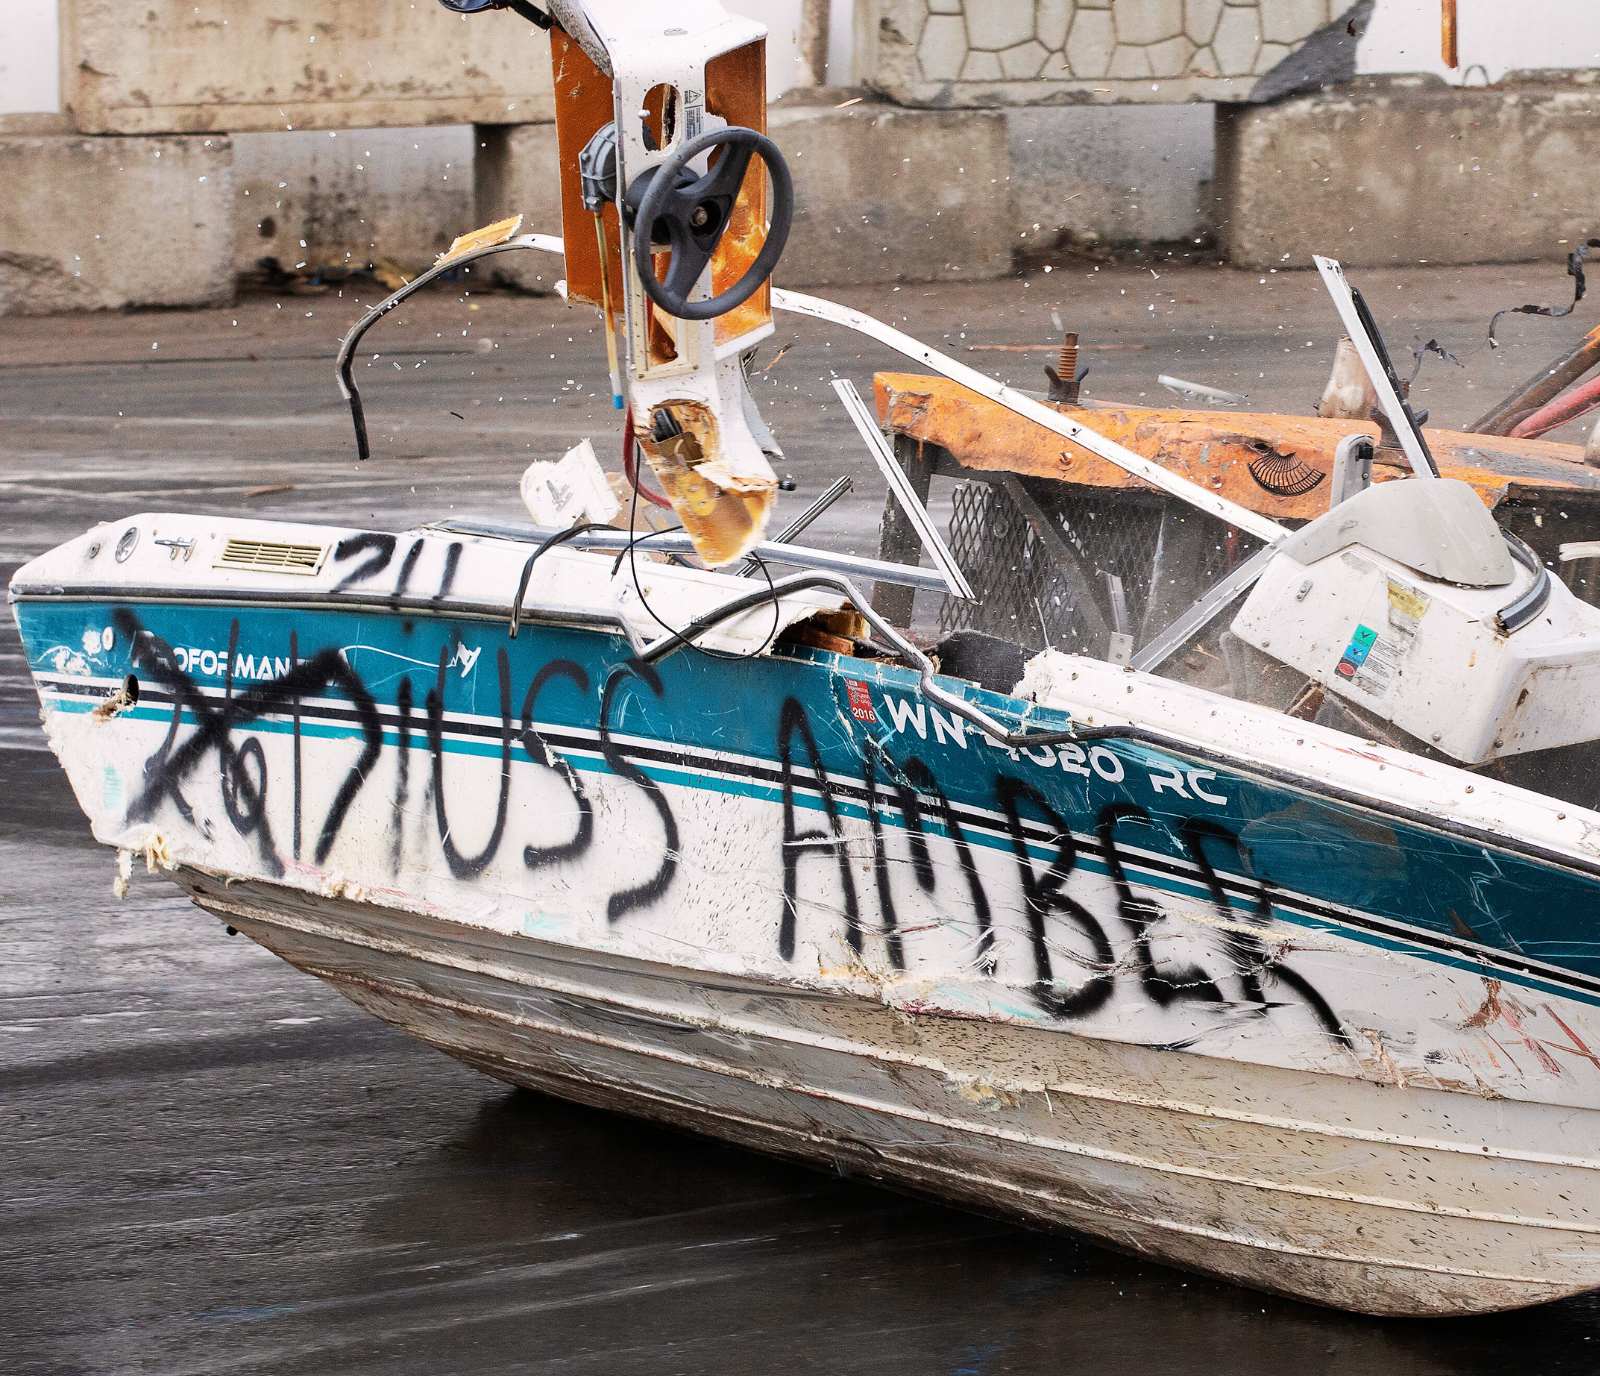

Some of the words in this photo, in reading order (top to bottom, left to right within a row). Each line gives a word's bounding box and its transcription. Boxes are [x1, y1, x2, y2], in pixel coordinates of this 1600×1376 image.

[852, 706, 876, 721] 2016
[884, 694, 967, 749] WN
[1145, 757, 1228, 806] RC
[777, 696, 1354, 1048] AMBER
